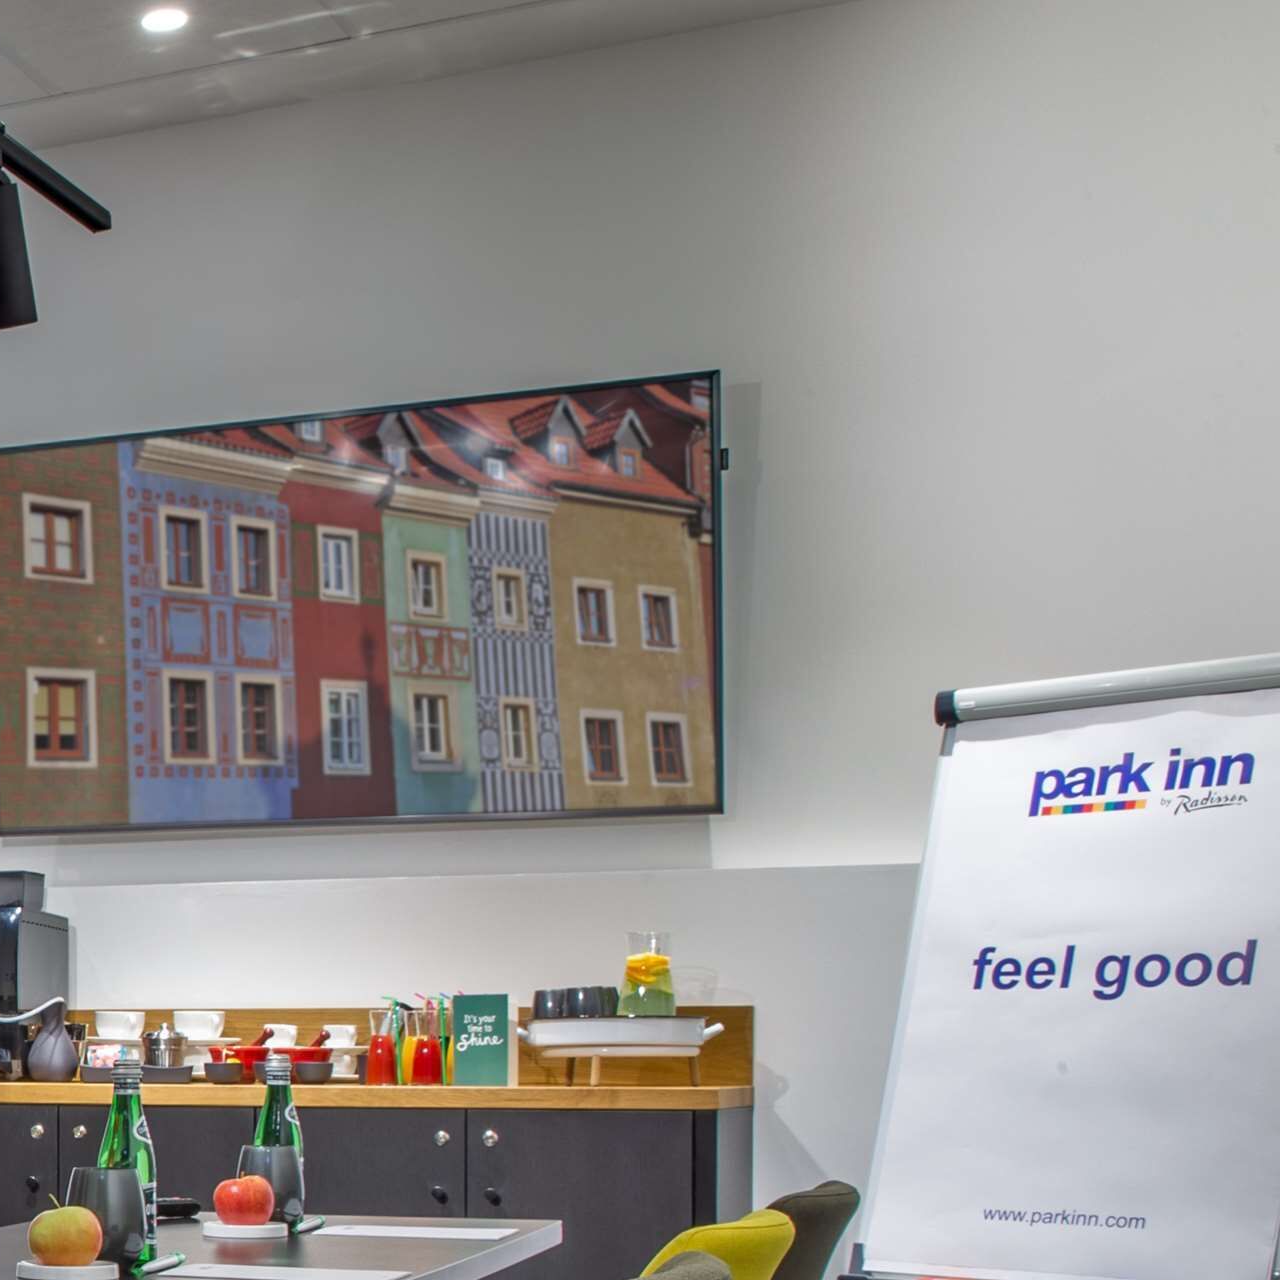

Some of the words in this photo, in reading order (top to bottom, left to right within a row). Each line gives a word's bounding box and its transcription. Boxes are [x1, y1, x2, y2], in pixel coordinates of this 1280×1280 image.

[1028, 752, 1155, 817] park
[1164, 748, 1255, 791] inn
[1160, 797, 1172, 807] by
[973, 944, 1076, 990] feel
[1093, 939, 1258, 1001] good
[983, 1208, 1147, 1230] www.parkinn.com
